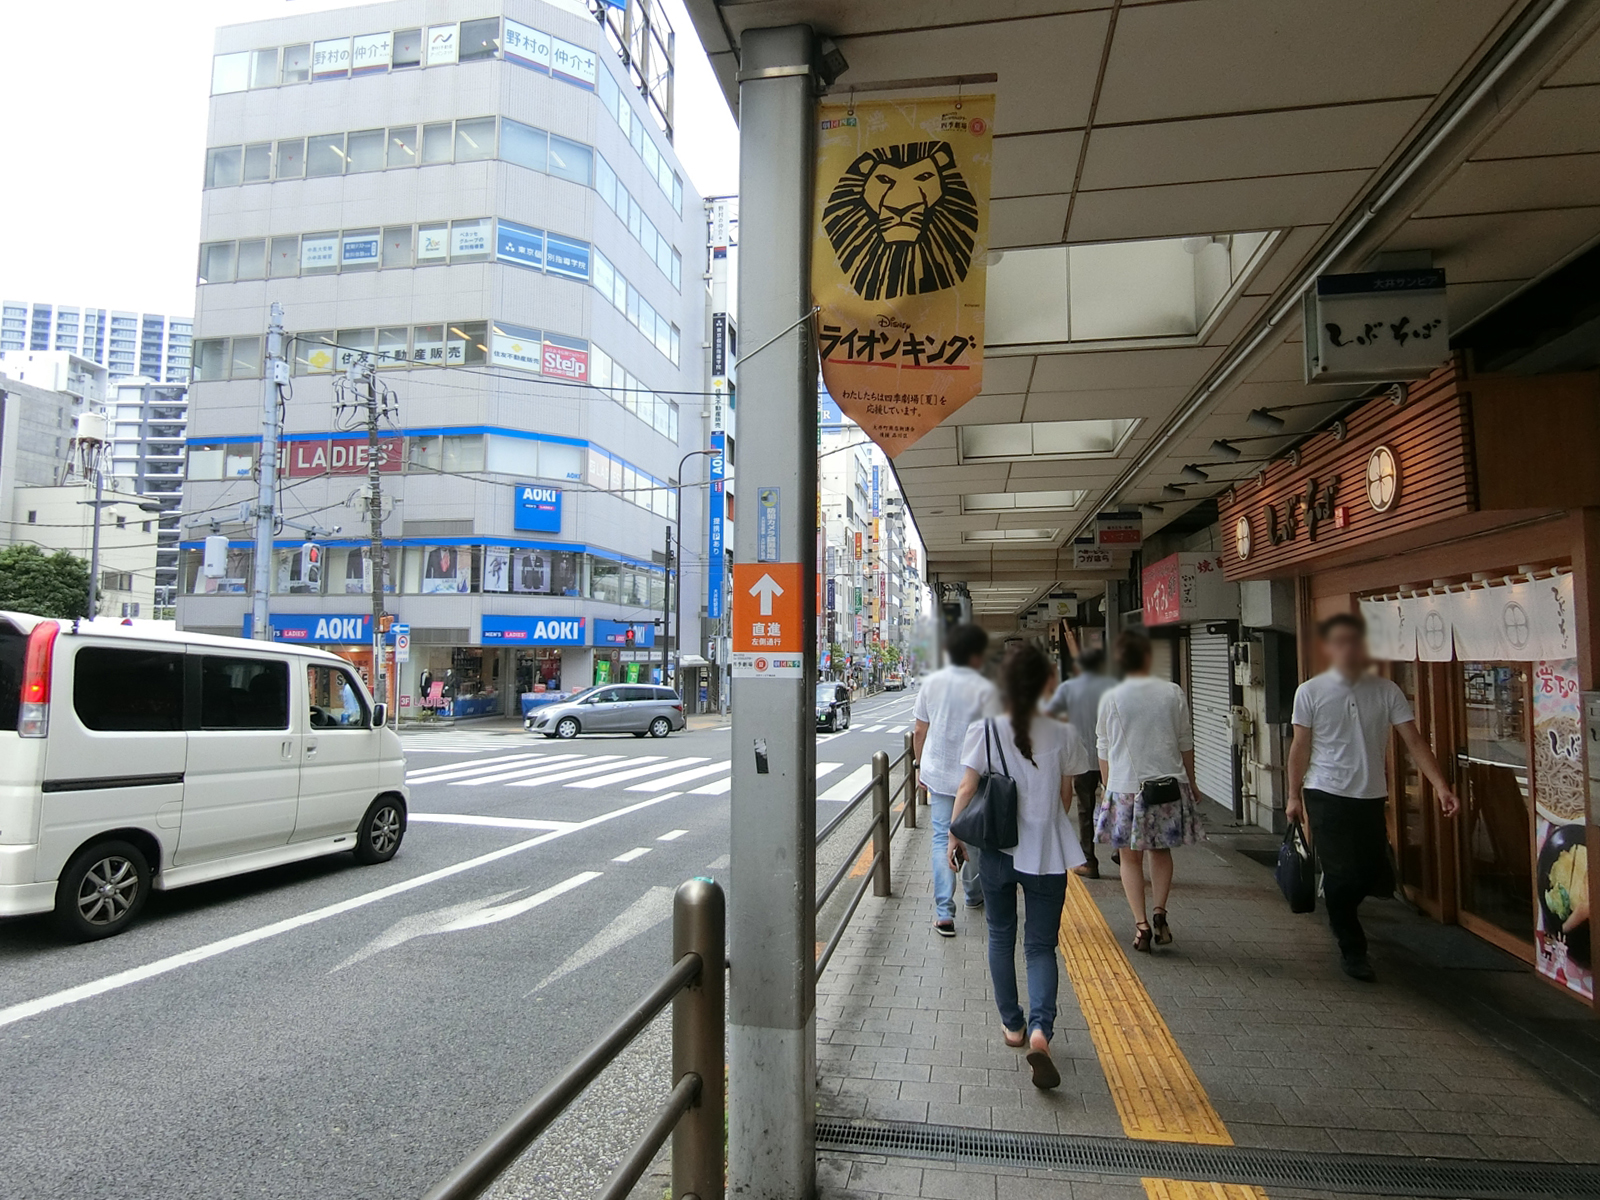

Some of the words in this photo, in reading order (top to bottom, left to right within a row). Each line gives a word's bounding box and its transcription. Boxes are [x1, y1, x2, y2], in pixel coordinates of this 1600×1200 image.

[517, 245, 586, 270] 東京個別指導学院
[1373, 276, 1438, 289] 大井サンピア
[876, 313, 911, 333] Disney
[819, 324, 977, 366] ライオンキング
[544, 352, 586, 378] Step
[865, 405, 922, 418] 応援しています。
[752, 621, 781, 637] 直進
[751, 638, 781, 646] 左側通行
[400, 698, 409, 706] 3F
